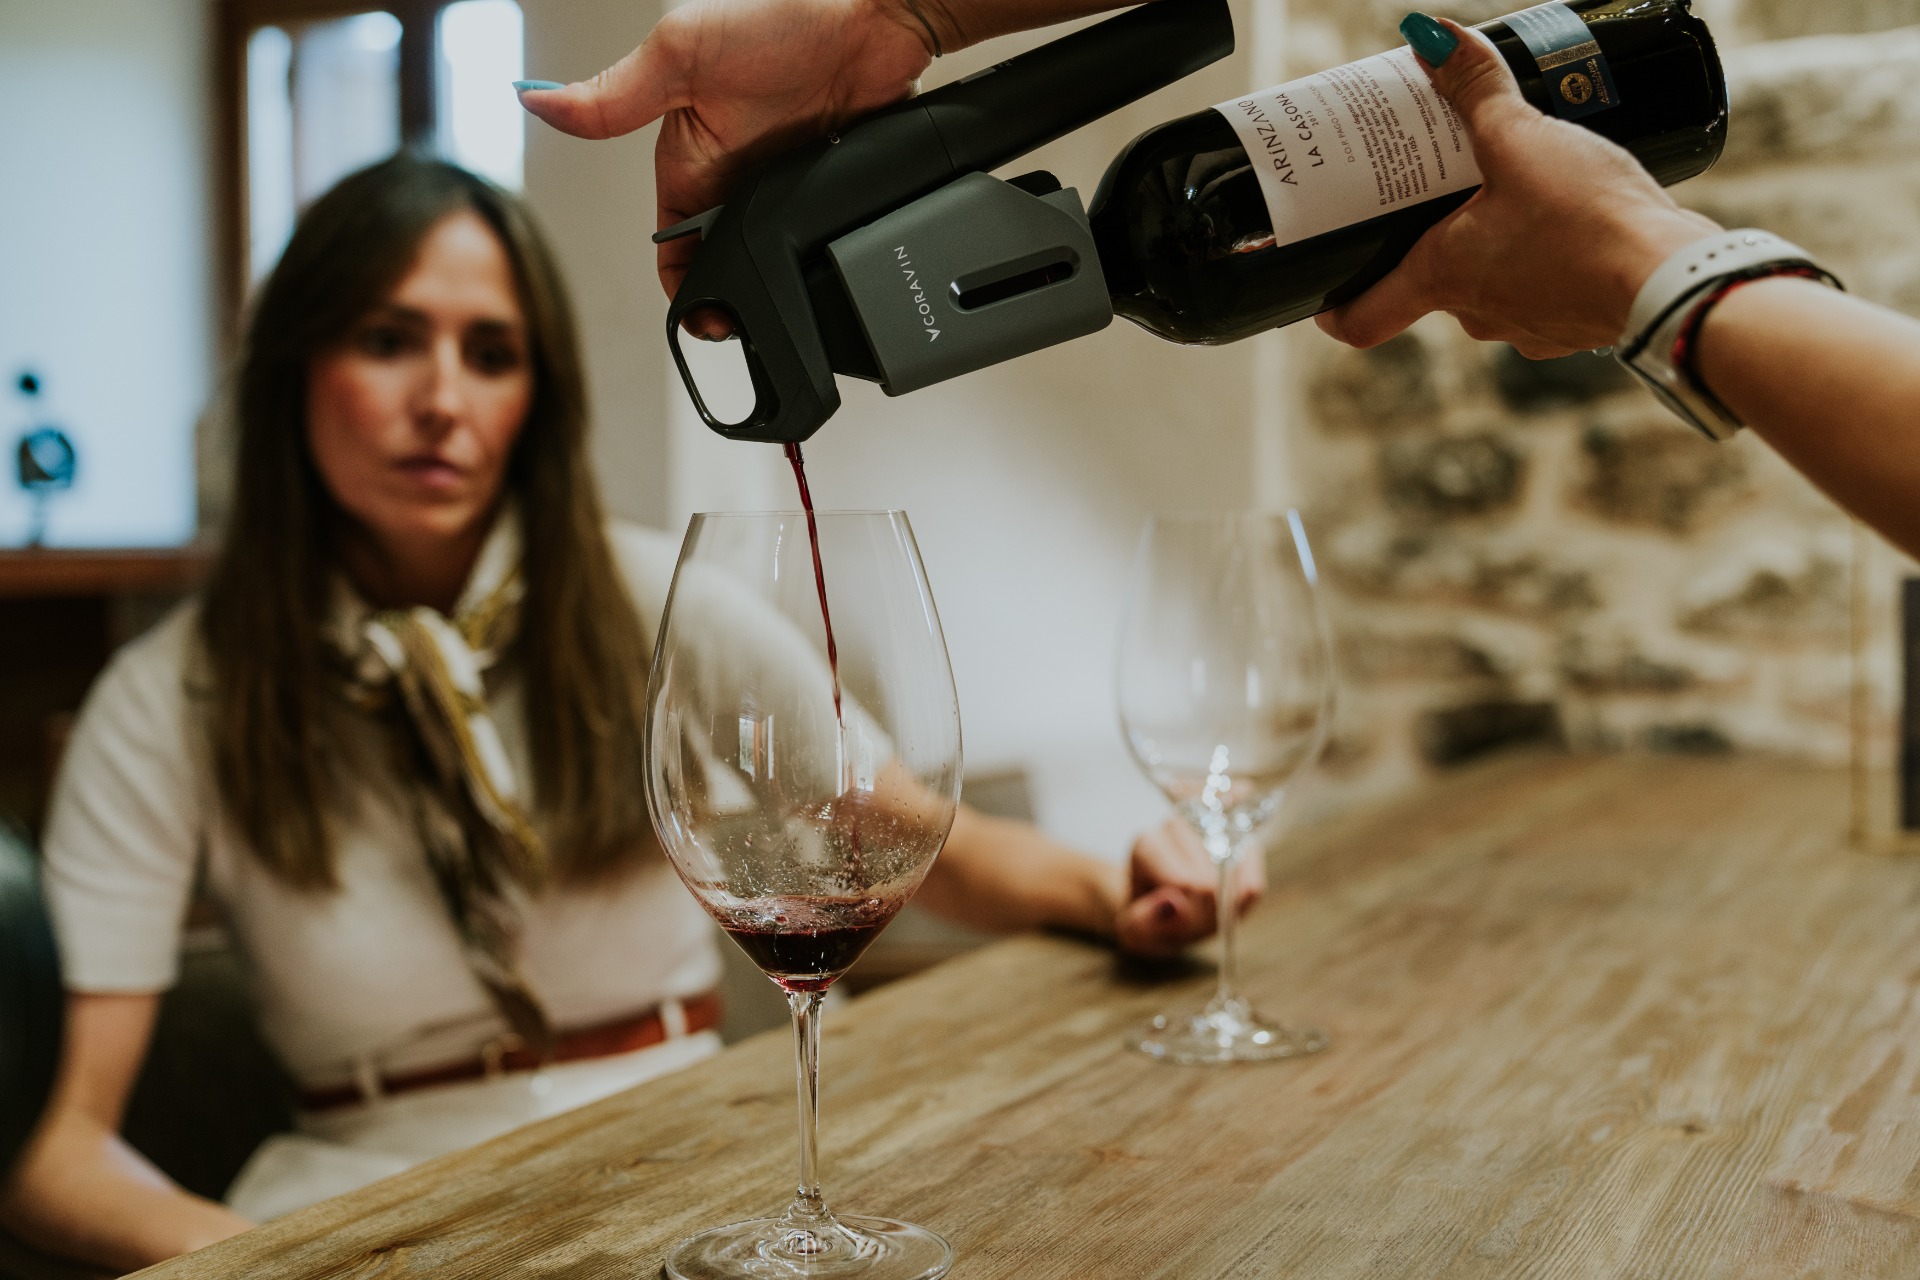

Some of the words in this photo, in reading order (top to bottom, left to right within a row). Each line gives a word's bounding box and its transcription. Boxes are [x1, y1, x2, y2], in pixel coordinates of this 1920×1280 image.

[1405, 82, 1415, 93] POR
[1275, 93, 1312, 141] CASONA
[1305, 110, 1319, 127] 2015
[1325, 107, 1334, 116] DE
[1345, 103, 1361, 125] degustar
[1356, 104, 1372, 126] perfecta
[1367, 108, 1380, 127] terroir
[1386, 107, 1399, 127] terroir
[1412, 93, 1434, 135] EMBOTELLADO
[1442, 110, 1450, 118] DE
[1331, 118, 1345, 139] PAGO
[1395, 130, 1405, 140] del
[1446, 119, 1461, 152] PRODUCTO
[1307, 145, 1324, 168] LA
[1361, 134, 1374, 159] detiene
[1382, 138, 1394, 164] adaptan
[1393, 142, 1401, 157] vino
[1402, 143, 1413, 166] misma
[1371, 160, 1377, 169] se
[1378, 155, 1390, 182] encarna
[1397, 159, 1405, 170] Un
[1431, 140, 1446, 180] PRODUCIDO
[1391, 167, 1398, 176] se
[1410, 169, 1419, 195] esencia
[1417, 162, 1429, 192] remonta
[1374, 171, 1384, 196] tiempo
[1385, 183, 1395, 203] blend
[1394, 180, 1403, 200] mejor
[1379, 198, 1387, 206] El
[893, 245, 934, 325] CORAVIN
